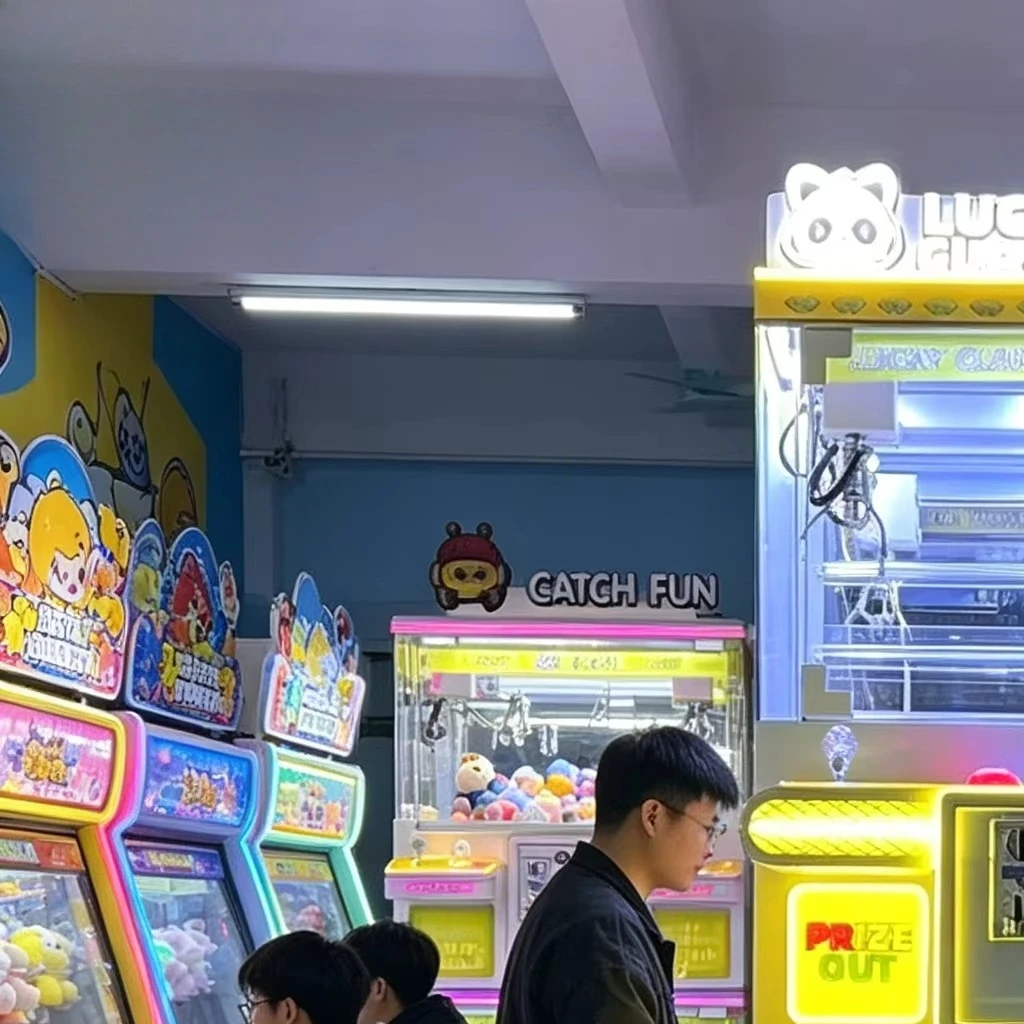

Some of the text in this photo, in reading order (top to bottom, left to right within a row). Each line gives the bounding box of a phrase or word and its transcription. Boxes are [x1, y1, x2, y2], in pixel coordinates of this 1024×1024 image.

[527, 571, 720, 609] CATCH FUN
[804, 921, 912, 952] PRIZE
[818, 953, 898, 984] OUT
